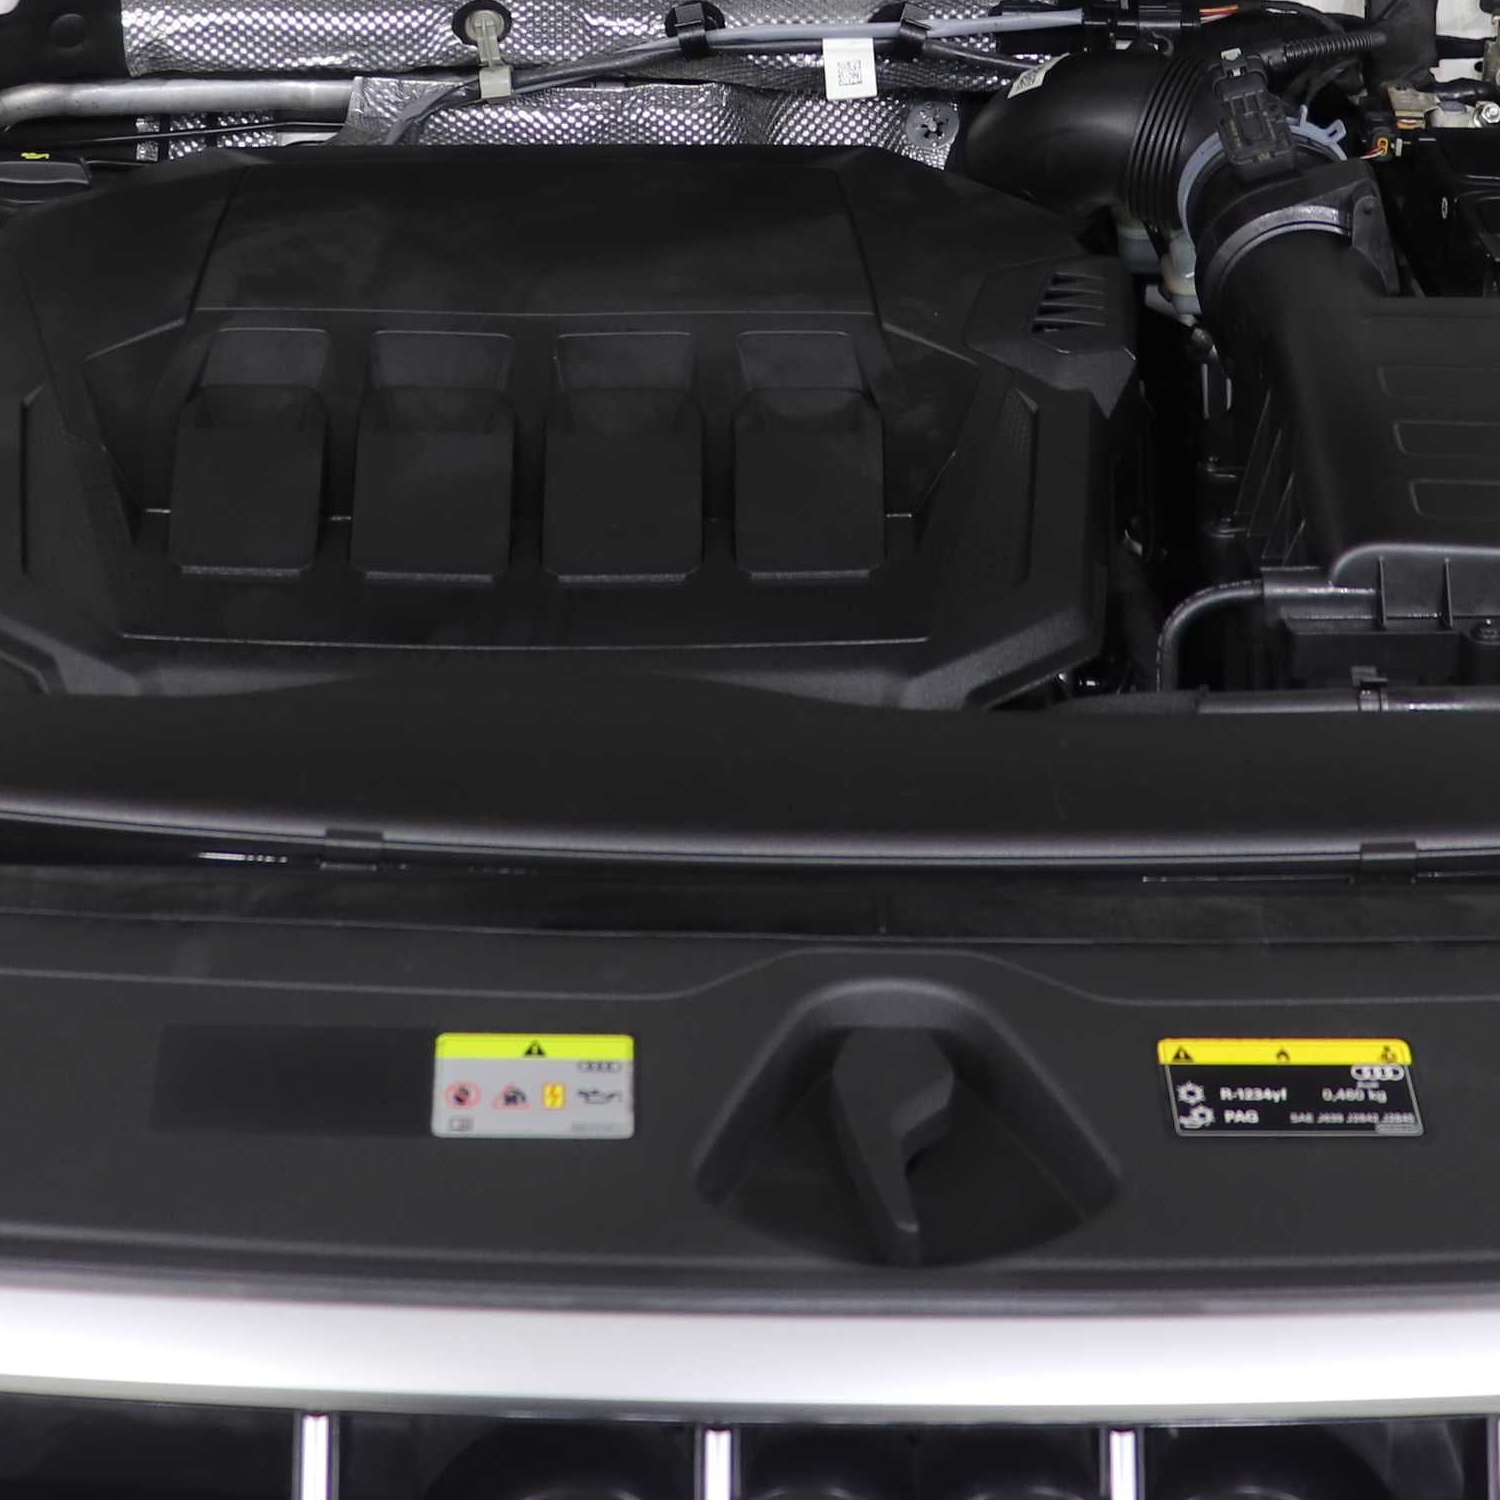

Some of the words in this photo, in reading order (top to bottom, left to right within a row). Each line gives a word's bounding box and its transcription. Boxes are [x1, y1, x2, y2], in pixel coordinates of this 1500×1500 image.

[1219, 1086, 1288, 1103] R-1234yf
[1367, 1088, 1388, 1104] kg
[1223, 1109, 1259, 1124] PAG
